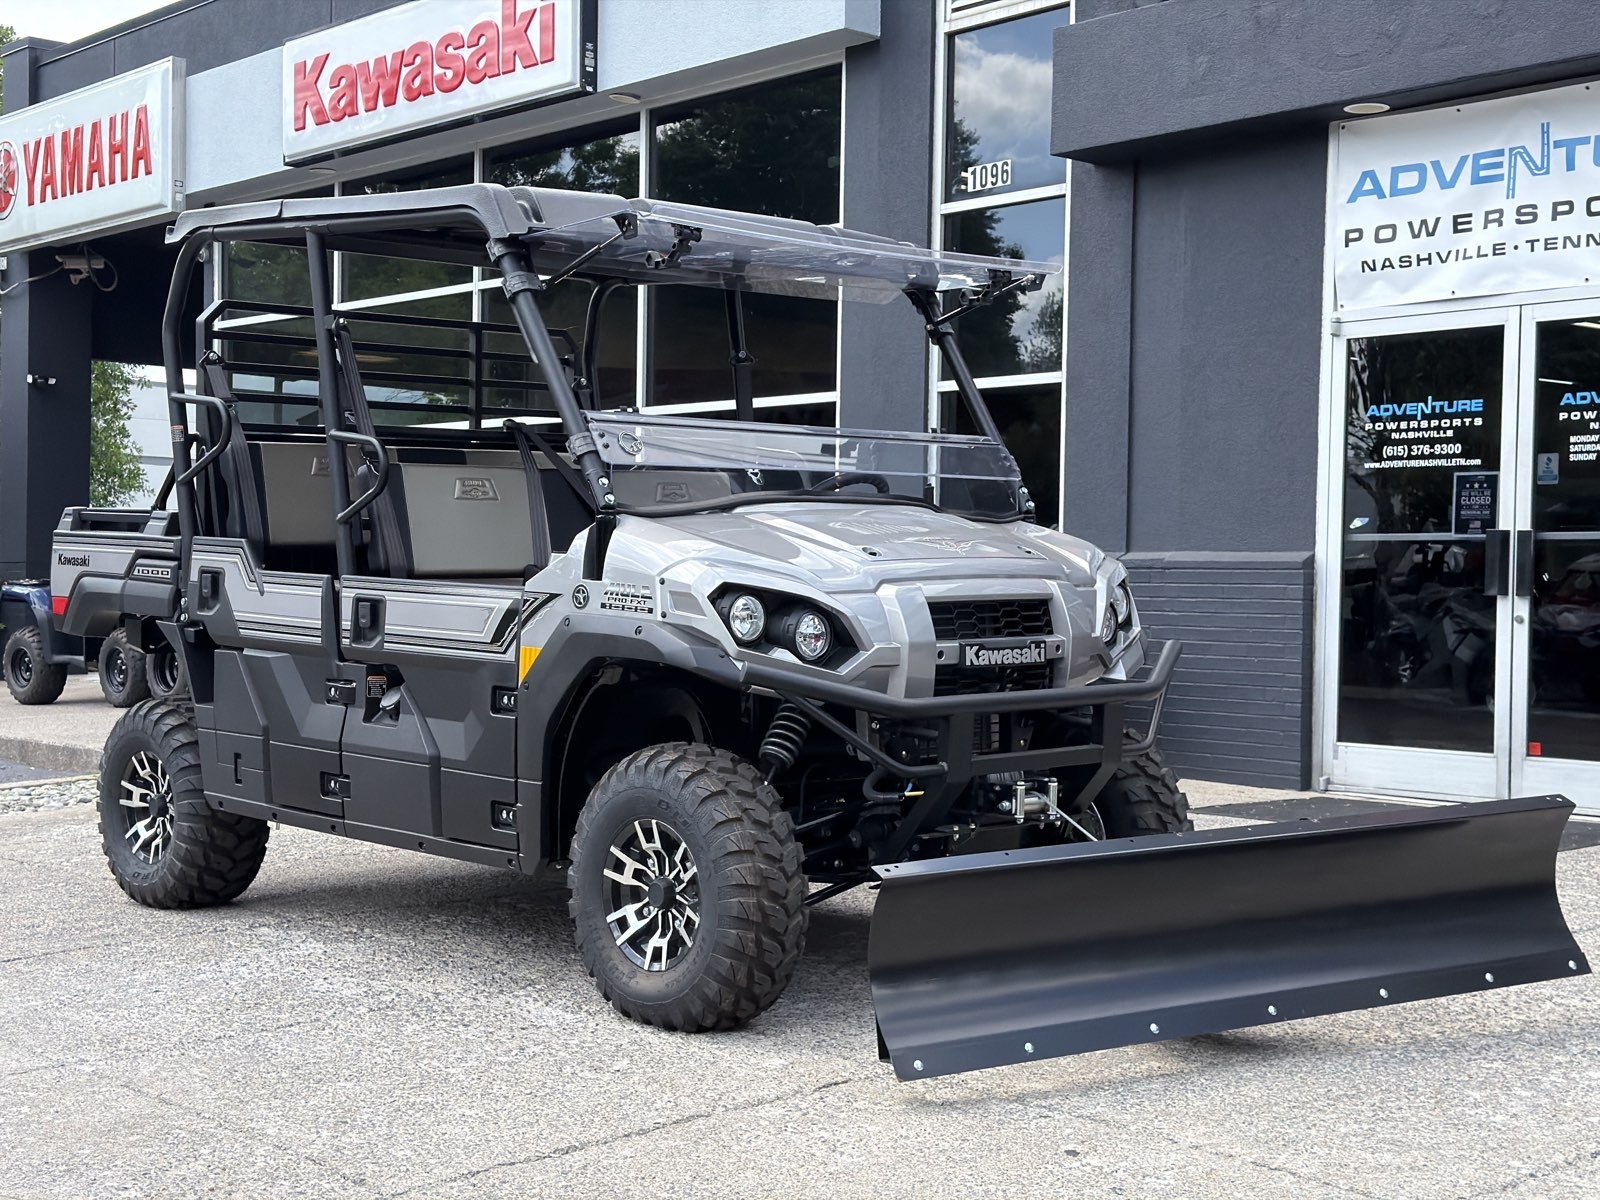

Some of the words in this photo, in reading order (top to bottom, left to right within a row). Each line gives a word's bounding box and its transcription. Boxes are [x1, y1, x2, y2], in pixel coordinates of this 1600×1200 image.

[292, 0, 556, 132] Kawasaki
[23, 103, 152, 207] YAMAHA
[1346, 121, 1600, 204] ADVENT
[970, 160, 1009, 190] 1096
[1366, 396, 1484, 421] ADVENTURE
[1364, 417, 1483, 431] POWERSPORTS
[1391, 430, 1454, 440] NASHVILLE
[1569, 434, 1600, 443] MONDAY
[1382, 444, 1408, 458] (615)
[1410, 443, 1462, 456] 376-9300
[1569, 453, 1597, 461] SUNDAY
[1364, 458, 1482, 469] www.ADVENTURENASHVILLETN.com
[1460, 496, 1491, 504] CLOSED
[57, 553, 91, 567] Kawasaki
[136, 567, 170, 576] 1000
[604, 583, 653, 599] MULE
[965, 643, 1045, 666] Kawasaki
